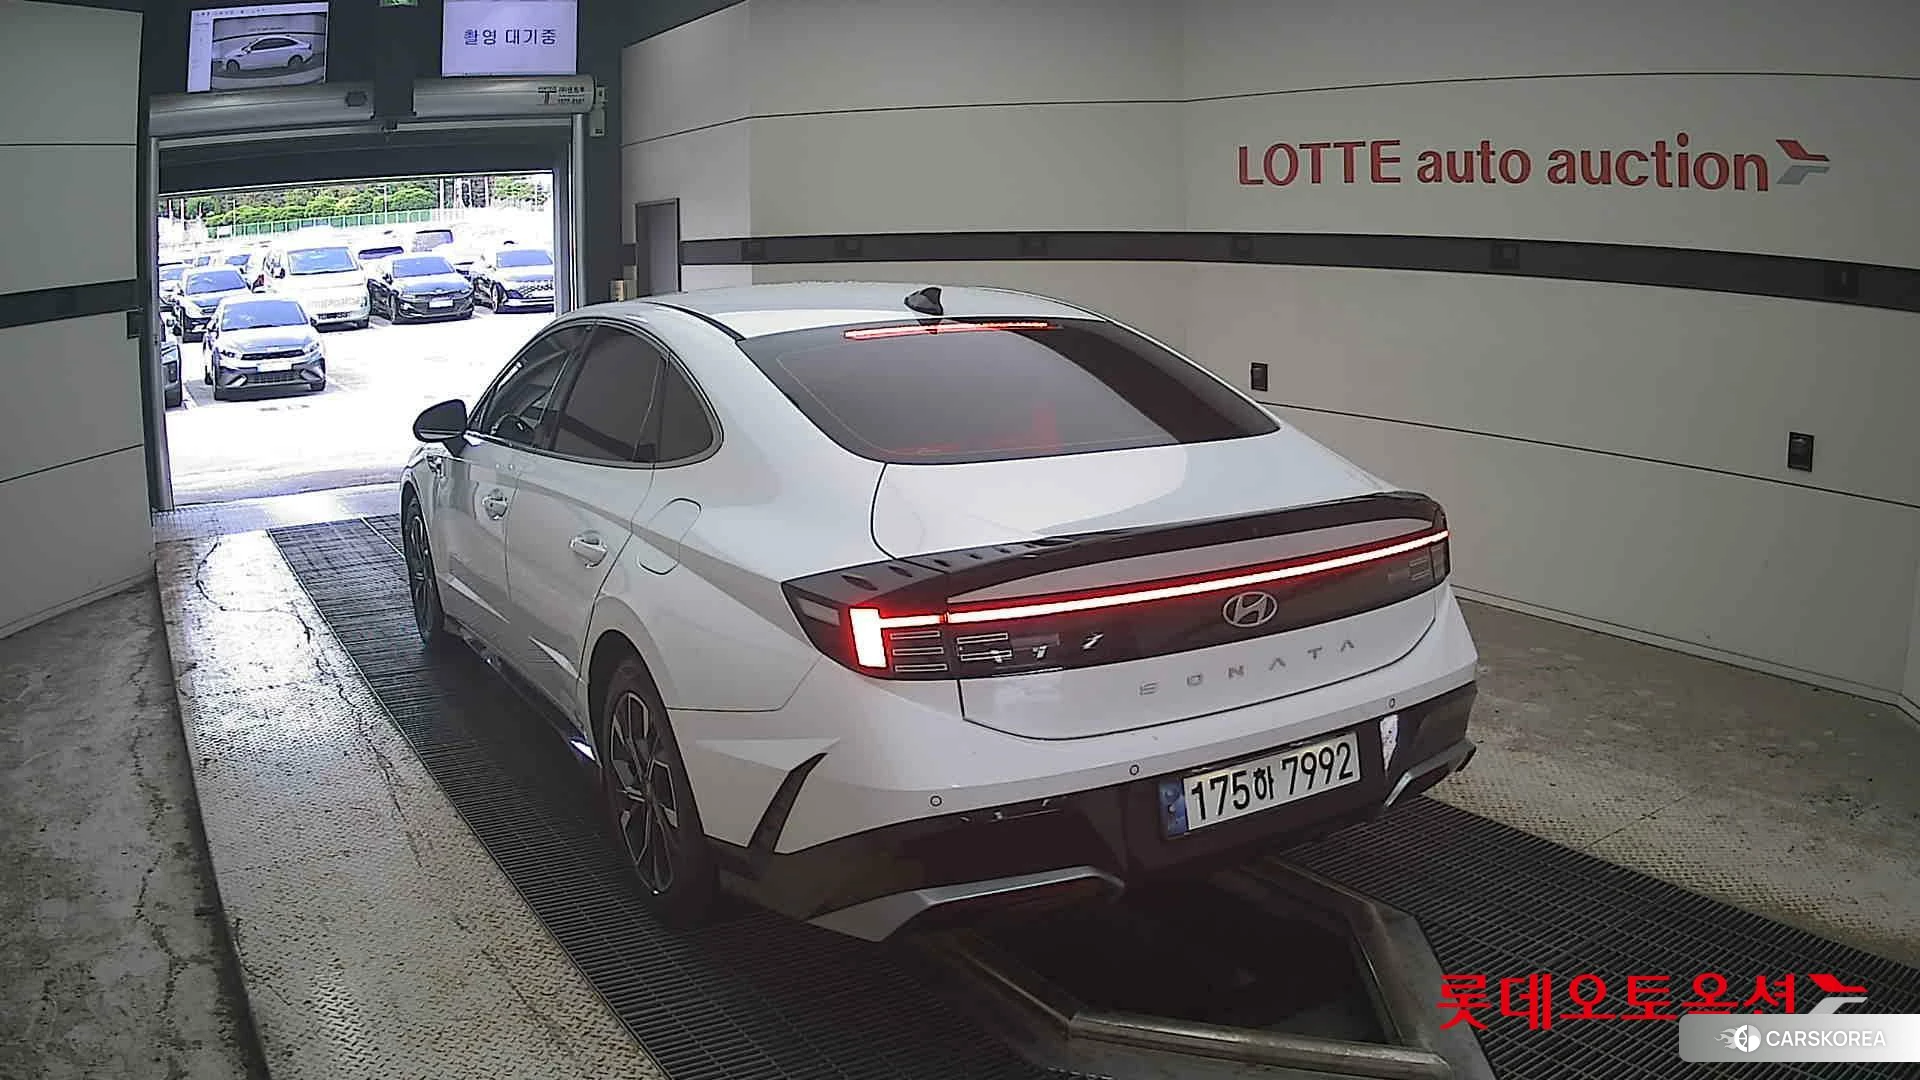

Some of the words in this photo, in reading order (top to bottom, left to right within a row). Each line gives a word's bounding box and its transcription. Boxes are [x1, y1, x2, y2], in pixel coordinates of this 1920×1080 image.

[464, 29, 497, 45] 촬영
[505, 29, 556, 45] 대기중
[1238, 139, 1401, 186] LOTTE
[1416, 139, 1532, 185] auto
[1547, 132, 1769, 192] auction
[1191, 765, 1275, 821] 175하
[1281, 742, 1354, 796] 7992
